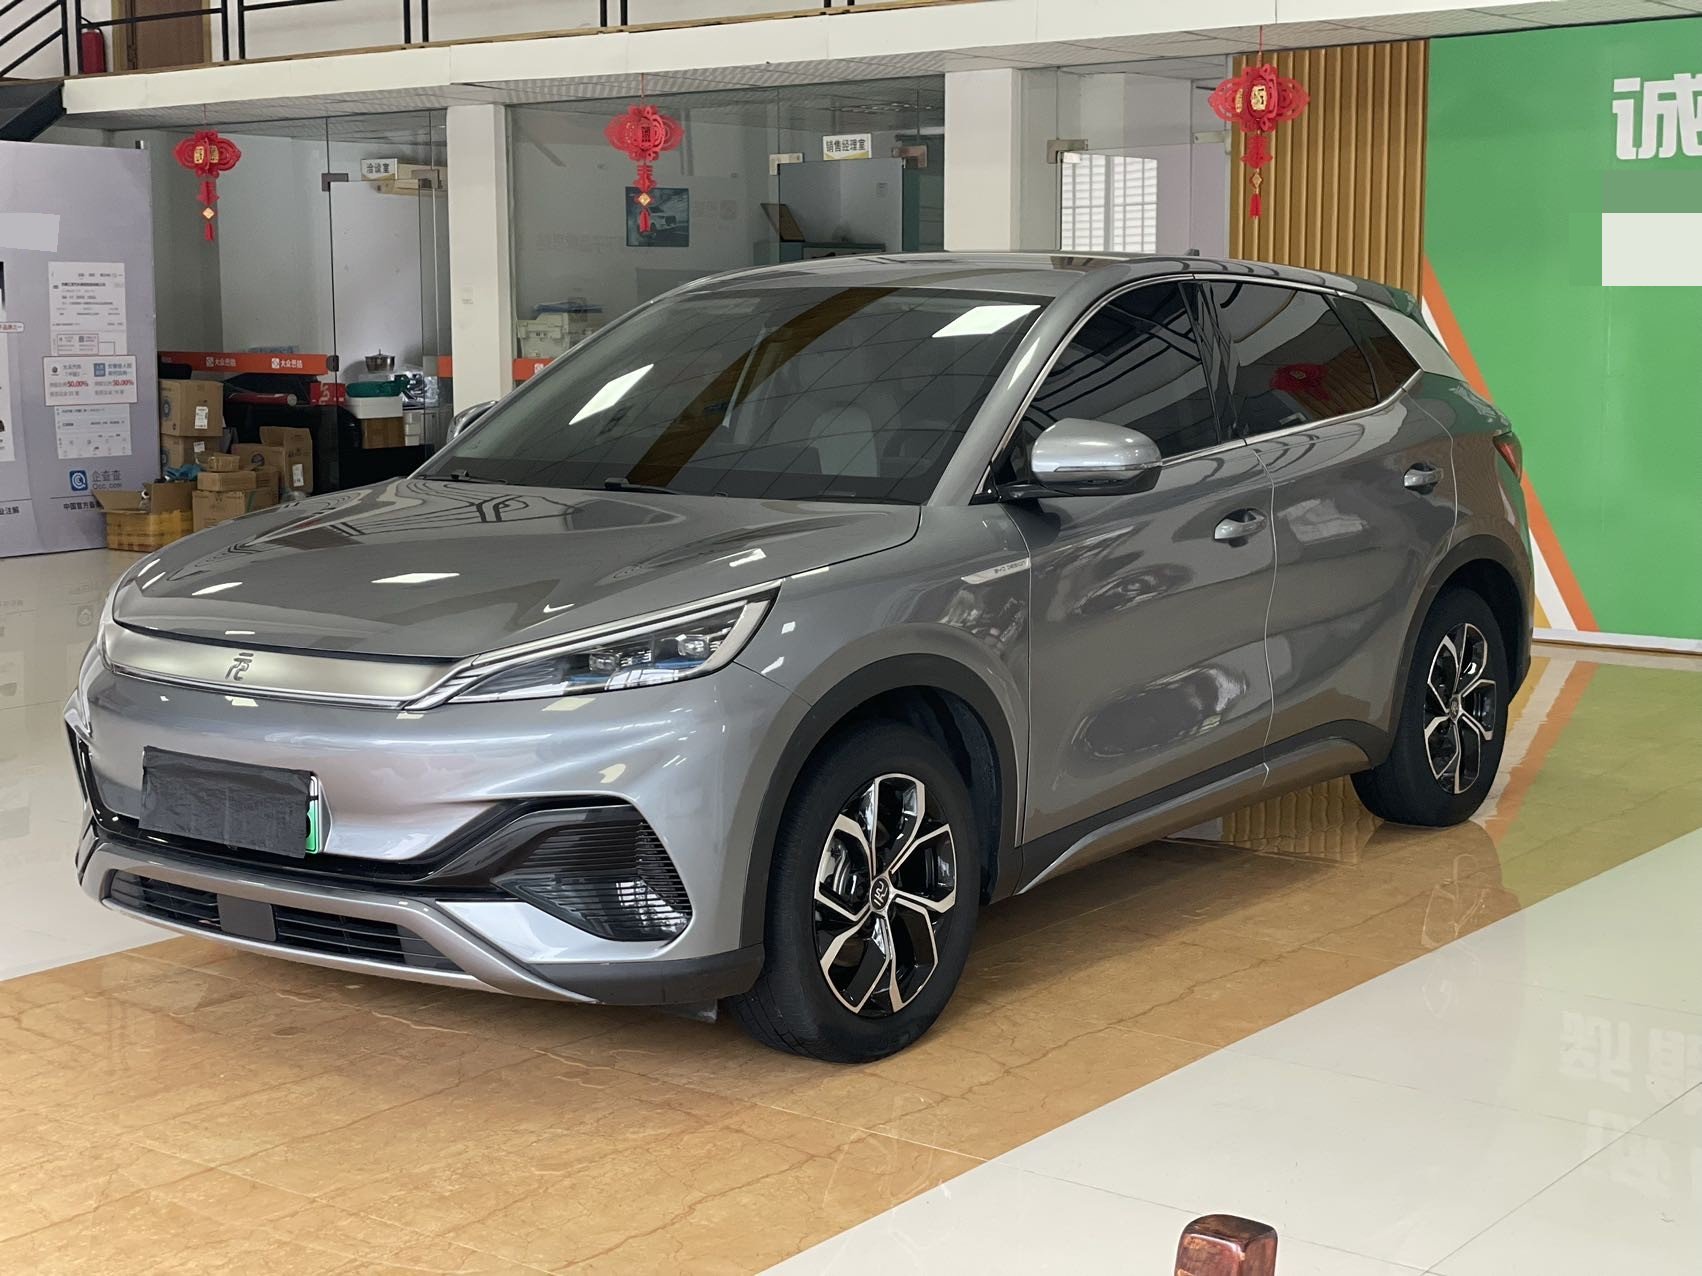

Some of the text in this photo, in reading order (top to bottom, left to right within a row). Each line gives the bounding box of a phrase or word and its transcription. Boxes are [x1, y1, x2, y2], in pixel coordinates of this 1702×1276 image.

[1612, 73, 1702, 160] 诚
[92, 470, 122, 482] 企查查
